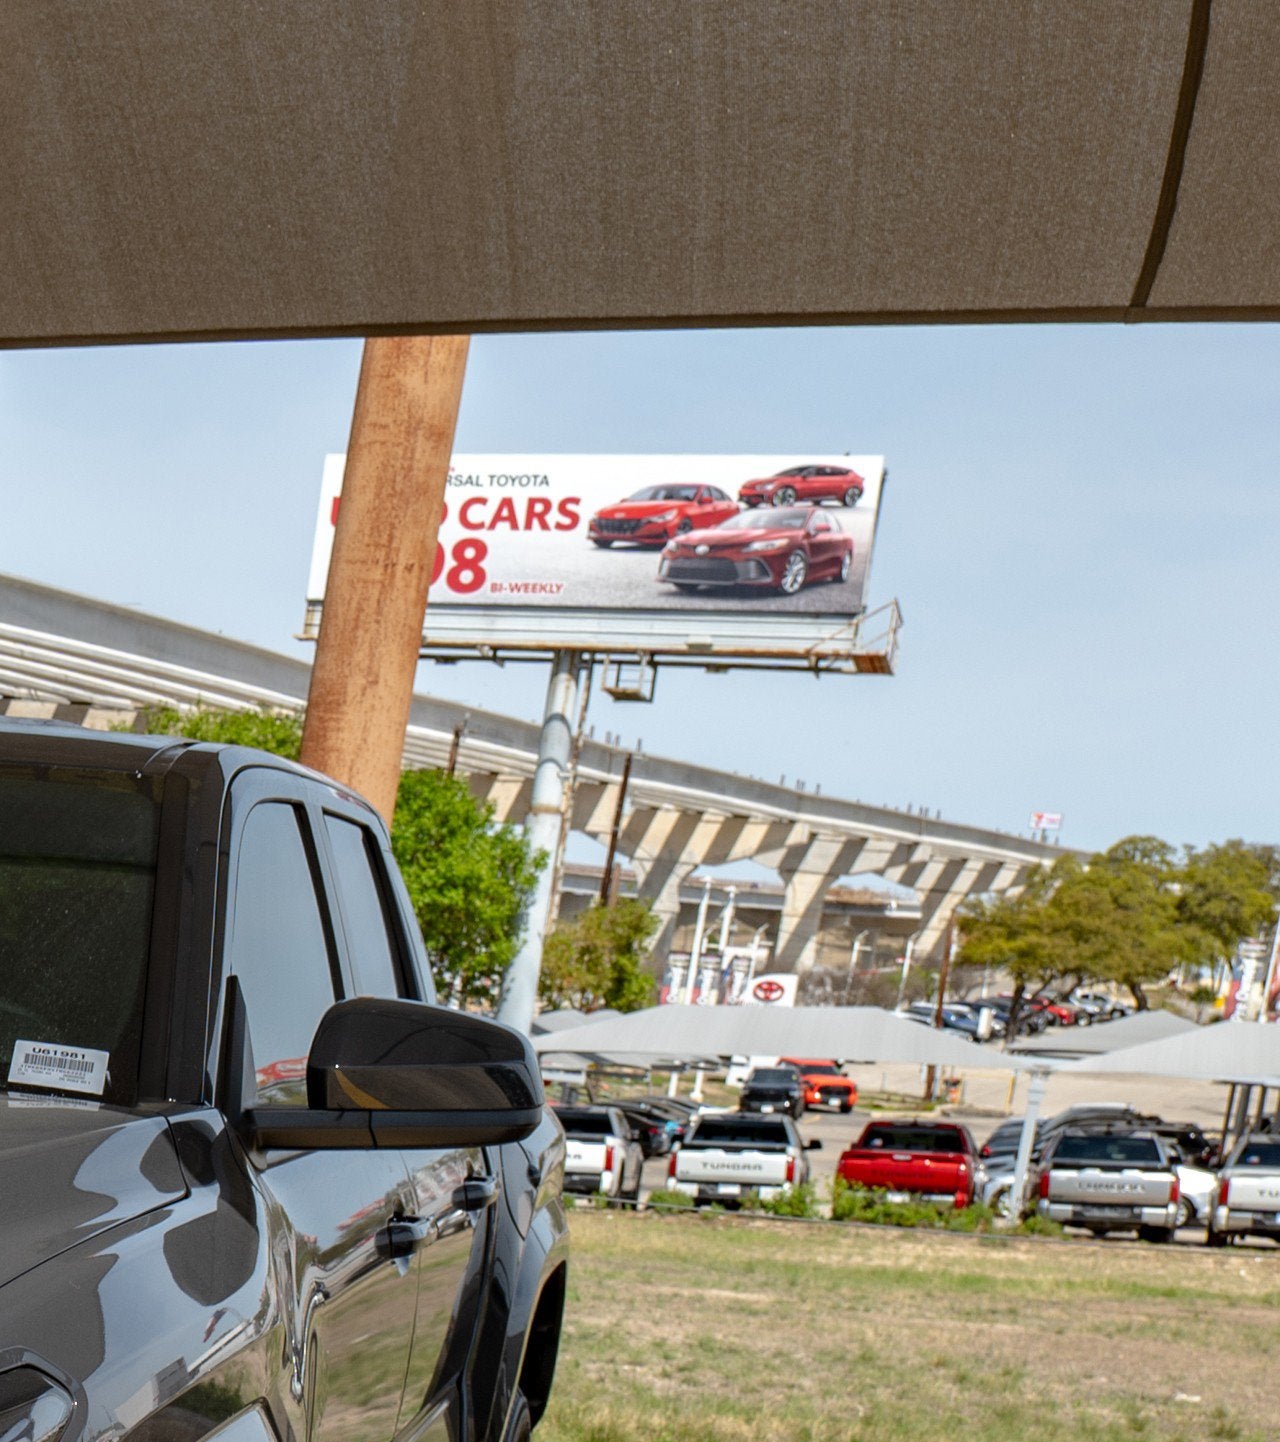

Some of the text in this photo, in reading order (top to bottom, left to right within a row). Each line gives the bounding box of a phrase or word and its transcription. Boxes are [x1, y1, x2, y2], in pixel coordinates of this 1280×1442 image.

[488, 474, 550, 488] TOYOTA
[458, 496, 582, 531] CARS
[490, 582, 564, 594] BI-WEEKLY
[700, 1160, 764, 1172] TUNDRA
